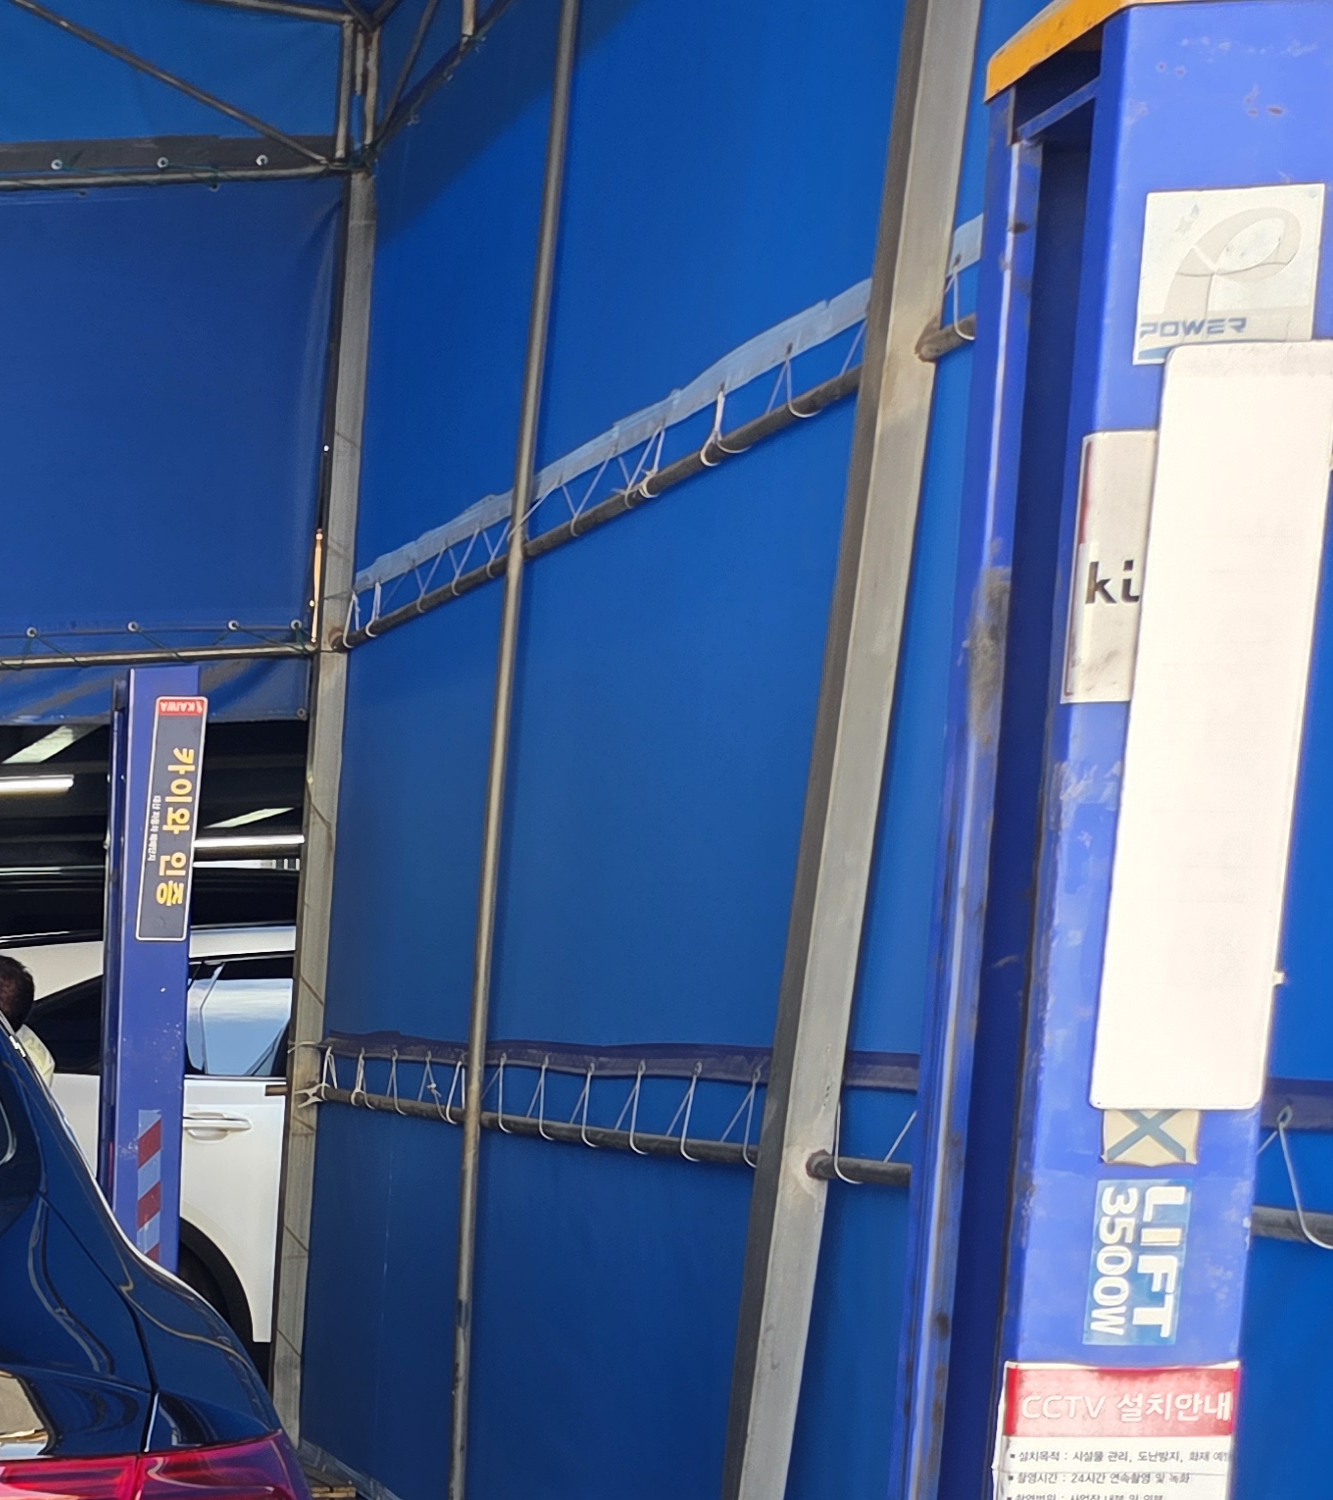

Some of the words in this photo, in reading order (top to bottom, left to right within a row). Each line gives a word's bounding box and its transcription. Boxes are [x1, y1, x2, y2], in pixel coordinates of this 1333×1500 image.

[1139, 317, 1247, 339] POWER
[161, 747, 196, 835] 카이와
[155, 851, 188, 907] 인증
[1090, 1185, 1139, 1337] 3500W
[1131, 1185, 1187, 1338] LIFT
[1021, 1394, 1106, 1419] CCTV
[1116, 1391, 1231, 1422] 설치안내
